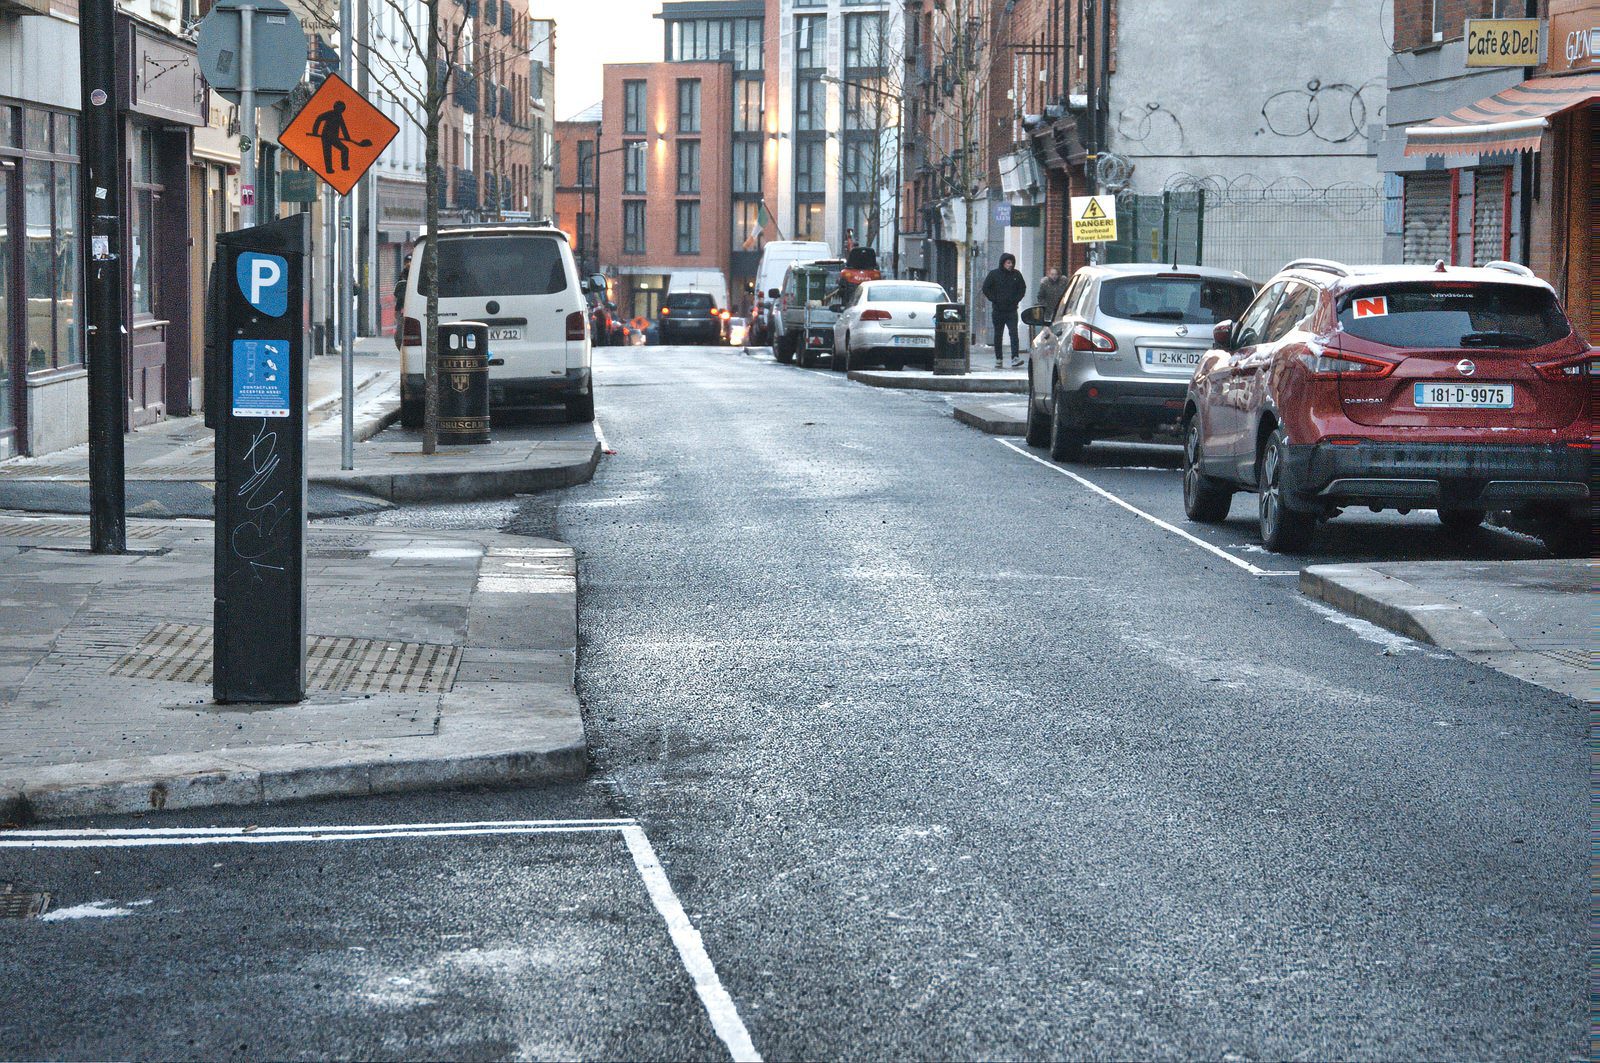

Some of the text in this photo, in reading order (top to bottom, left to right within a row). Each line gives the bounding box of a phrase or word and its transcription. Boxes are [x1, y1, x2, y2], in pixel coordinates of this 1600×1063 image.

[1468, 30, 1538, 56] Café & Deli
[1075, 219, 1114, 228] DANGER!
[251, 259, 280, 304] P
[1356, 298, 1384, 316] N
[490, 330, 518, 339] KY 212
[1159, 352, 1203, 364] 12-KK-102
[1430, 388, 1504, 404] 181-D-9975
